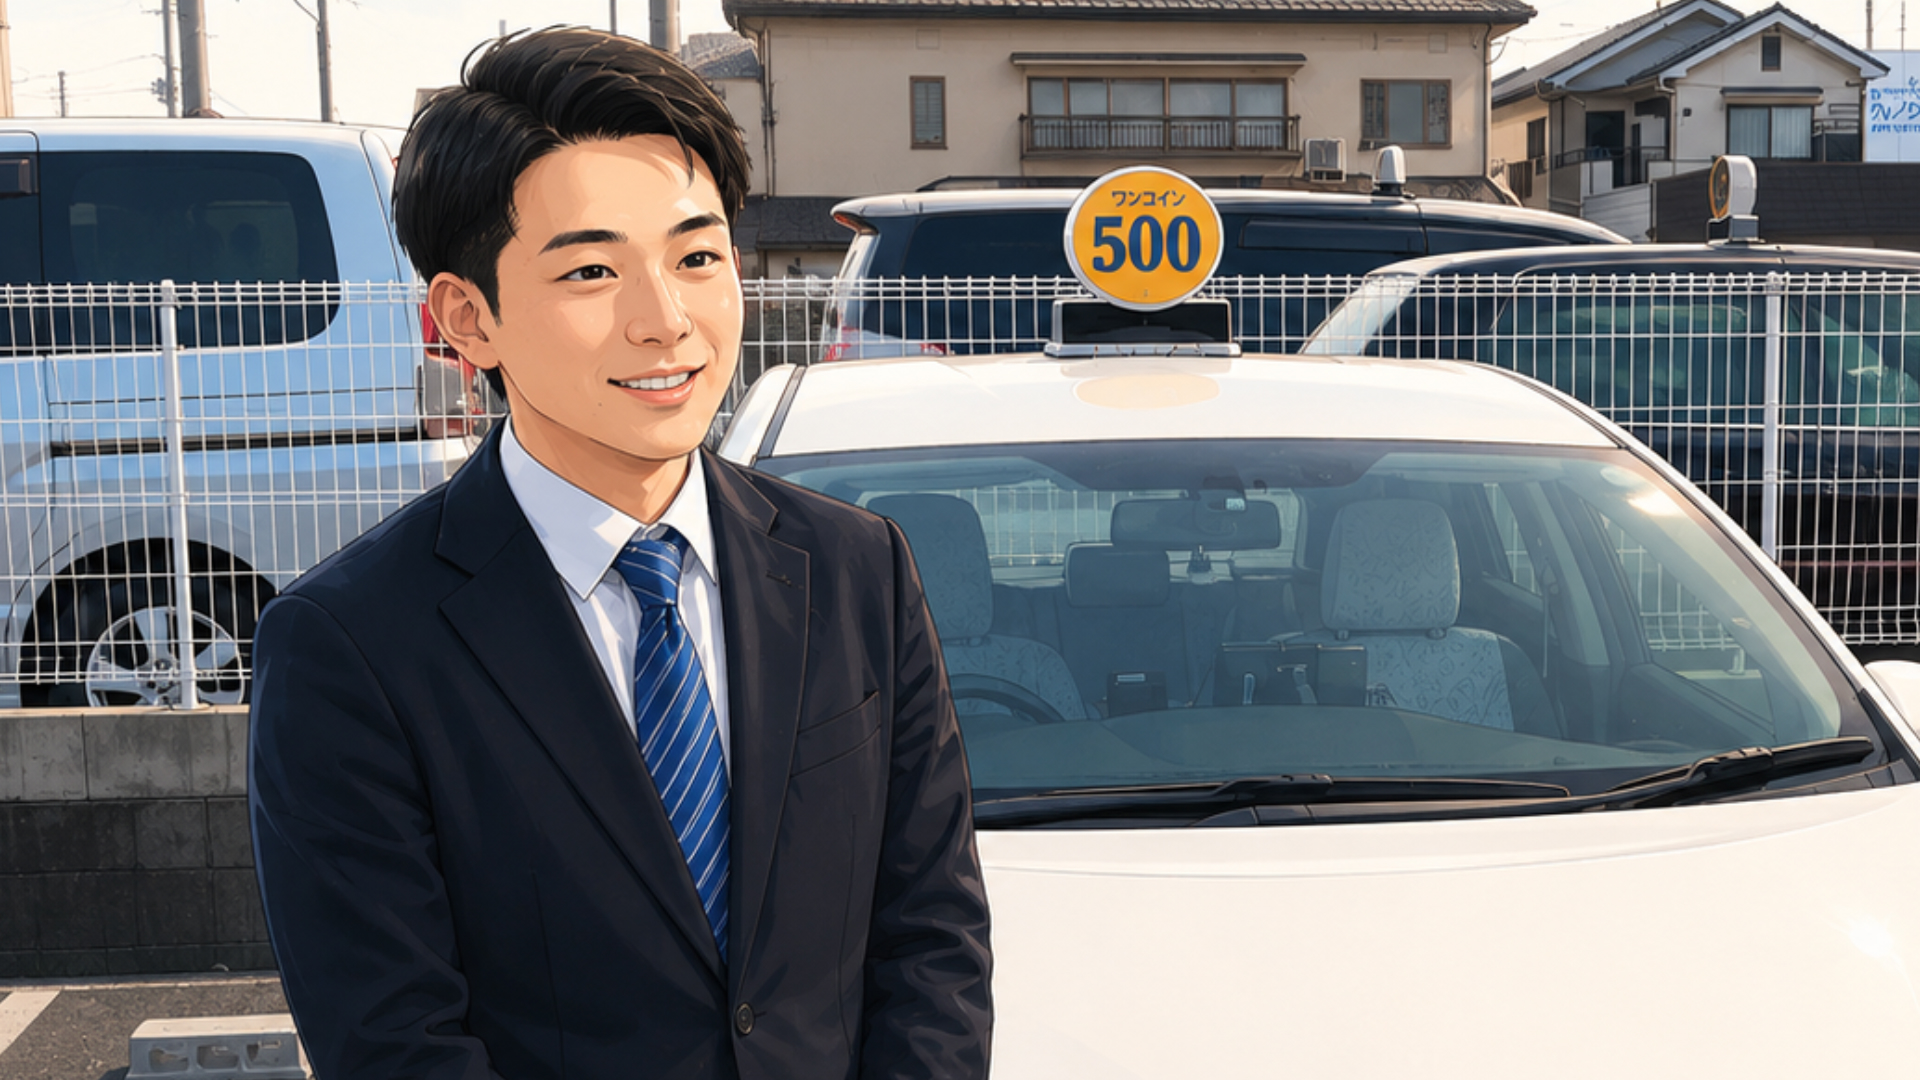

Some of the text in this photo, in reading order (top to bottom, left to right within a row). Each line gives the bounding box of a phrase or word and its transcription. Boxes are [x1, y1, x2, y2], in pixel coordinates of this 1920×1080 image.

[1112, 190, 1186, 207] ワンコイン
[1092, 215, 1201, 273] 500
